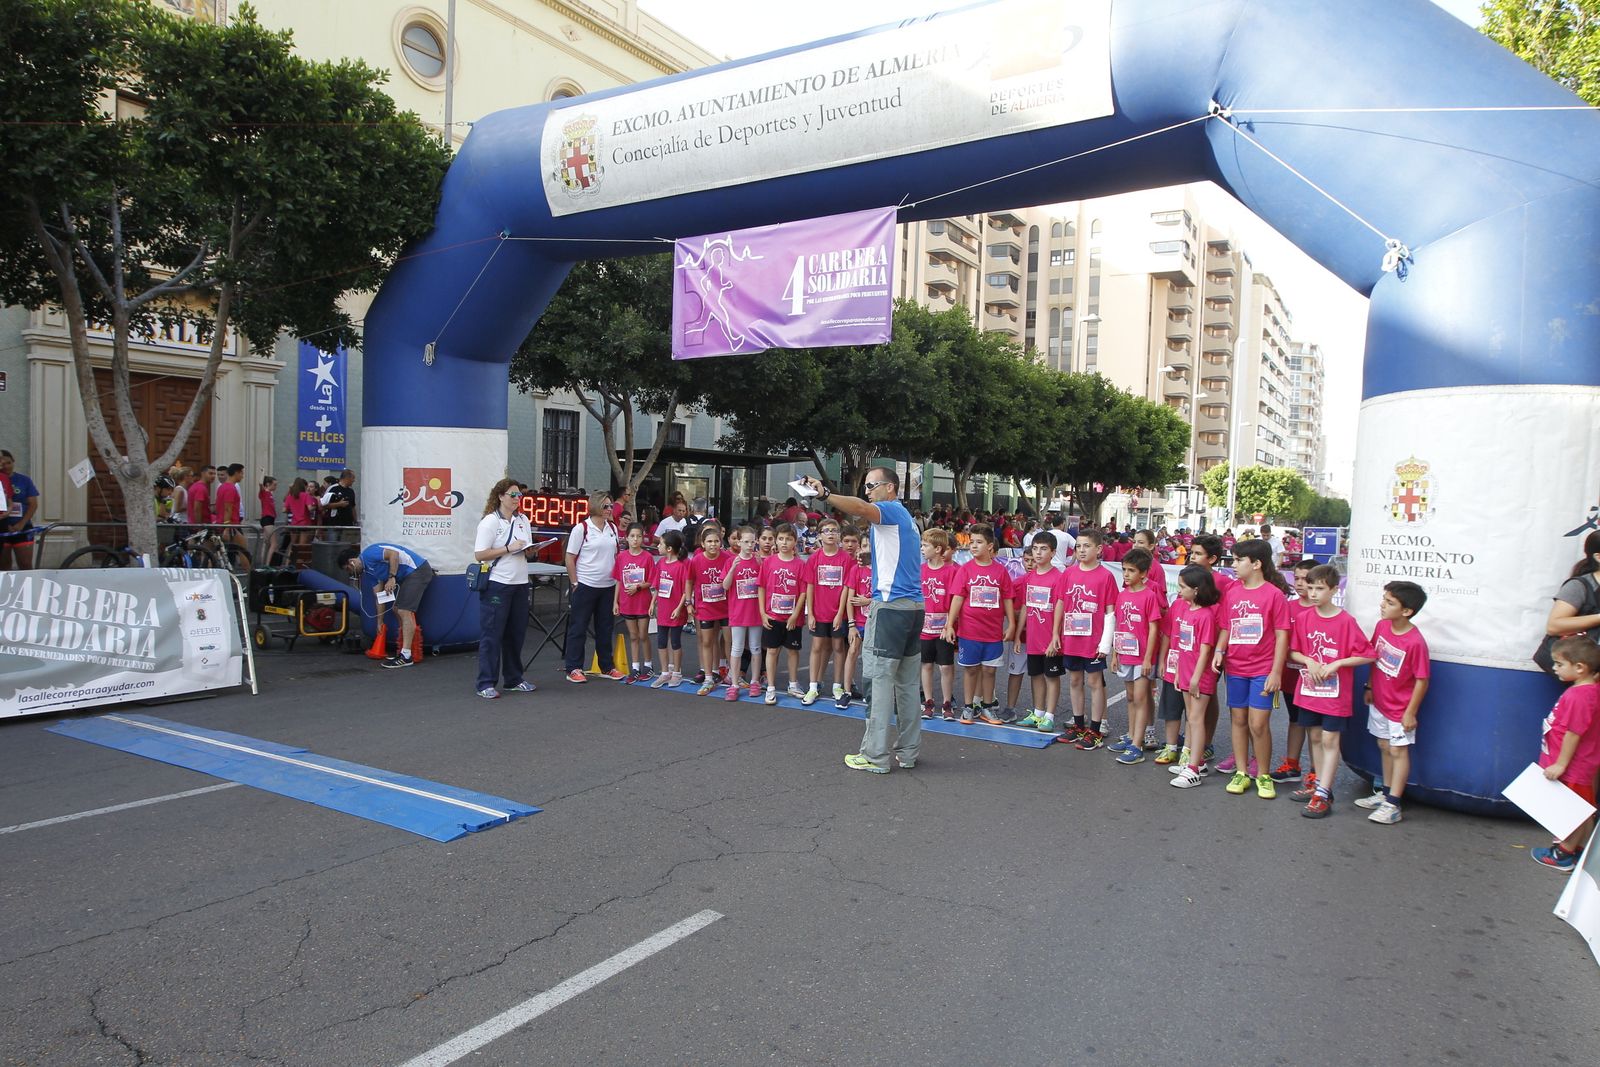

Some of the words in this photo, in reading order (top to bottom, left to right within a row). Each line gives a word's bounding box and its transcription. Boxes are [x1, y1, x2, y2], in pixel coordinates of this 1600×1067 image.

[612, 108, 673, 136] EXCMO.
[677, 74, 827, 122] AYUNTAMIENTO
[831, 65, 860, 88] DE
[990, 78, 1065, 104] DEPORTES
[991, 103, 1008, 116] DE
[612, 134, 689, 165] Concejalía
[694, 129, 713, 149] de
[717, 115, 797, 146] Deportes
[802, 112, 814, 133] y
[816, 86, 903, 131] Juventud
[781, 255, 810, 316] 4
[808, 244, 888, 275] CARRERA
[808, 266, 887, 294] SOLIDARIA
[300, 431, 344, 443] FELICES
[299, 456, 344, 464] COMPETENTES
[402, 521, 452, 529] DEPORTES
[1381, 534, 1435, 547] EXCMO.
[1360, 548, 1474, 566] AYUNTAMIENTO
[1366, 563, 1381, 574] DE
[1384, 564, 1454, 580] ALMERÍA
[1436, 584, 1479, 597] Juventud
[0, 610, 157, 659] OLIDARIA
[18, 647, 85, 662] ENFERMEDADES
[87, 654, 106, 665] POCO
[107, 656, 156, 671] FRECUENTES
[18, 679, 155, 703] lasallecorreparaayudar.com
